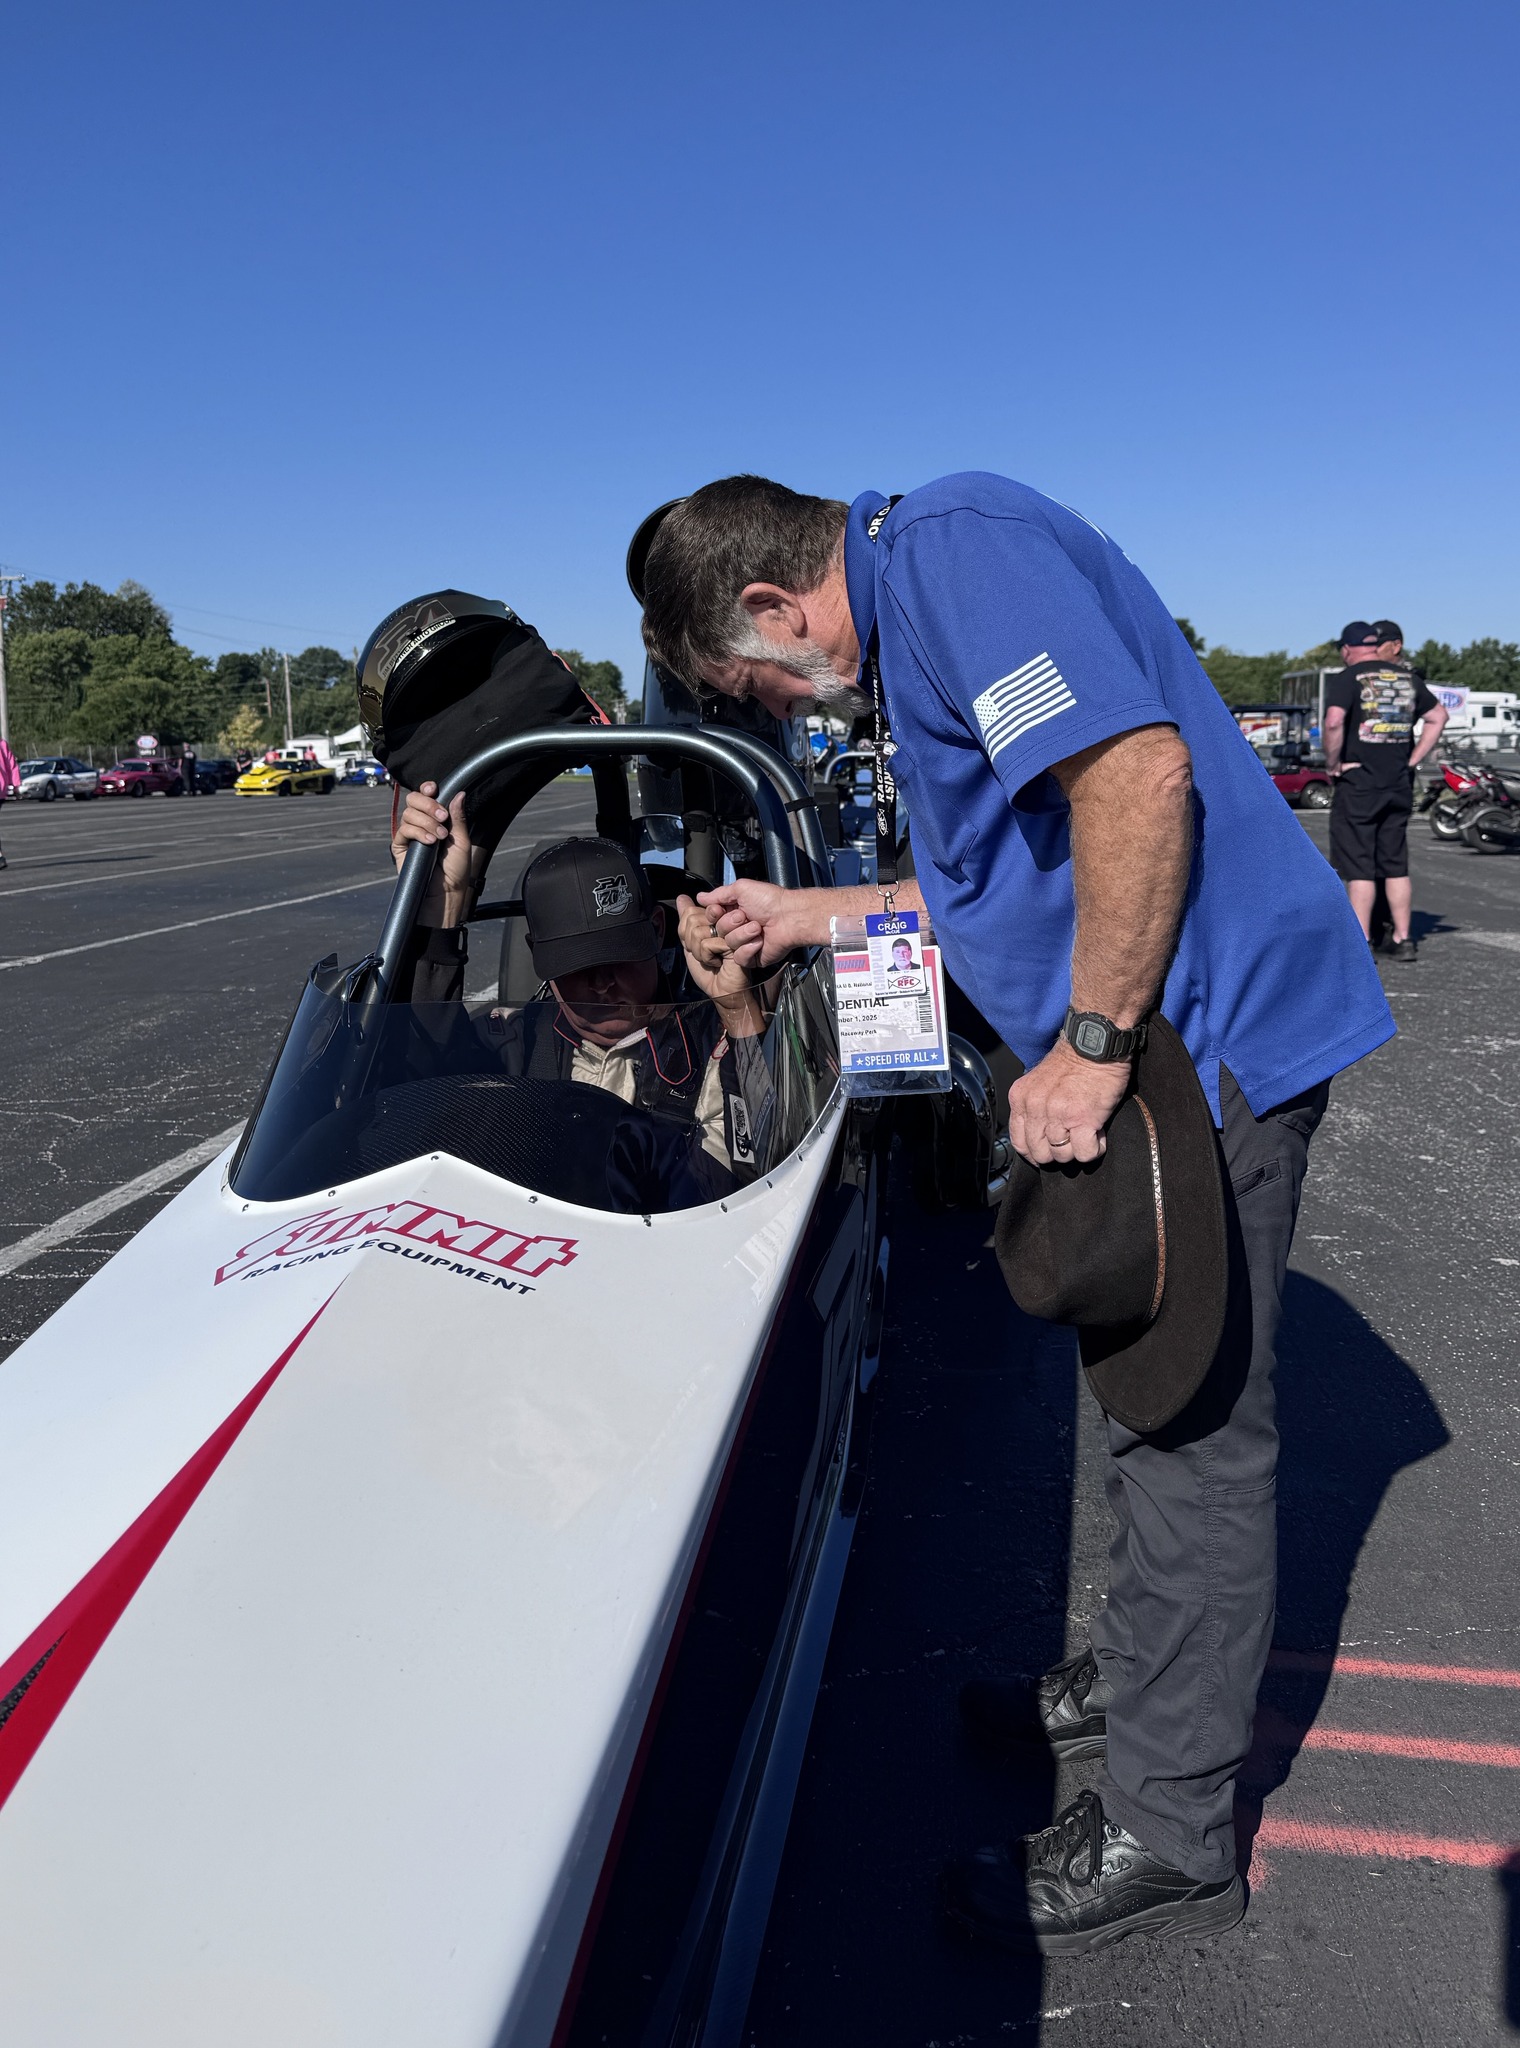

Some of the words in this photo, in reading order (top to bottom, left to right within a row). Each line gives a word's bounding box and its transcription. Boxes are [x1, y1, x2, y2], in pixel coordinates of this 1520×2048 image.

[877, 921, 907, 932] CRAIG
[870, 938, 885, 991] CHAPLAIN
[897, 979, 915, 987] RFC
[865, 1054, 892, 1067] SPEED
[894, 1053, 911, 1064] FOR
[913, 1051, 930, 1063] ALL
[241, 1244, 354, 1281] RACING
[358, 1238, 537, 1296] EQUIPMENT
[1101, 1857, 1132, 1877] ILA
